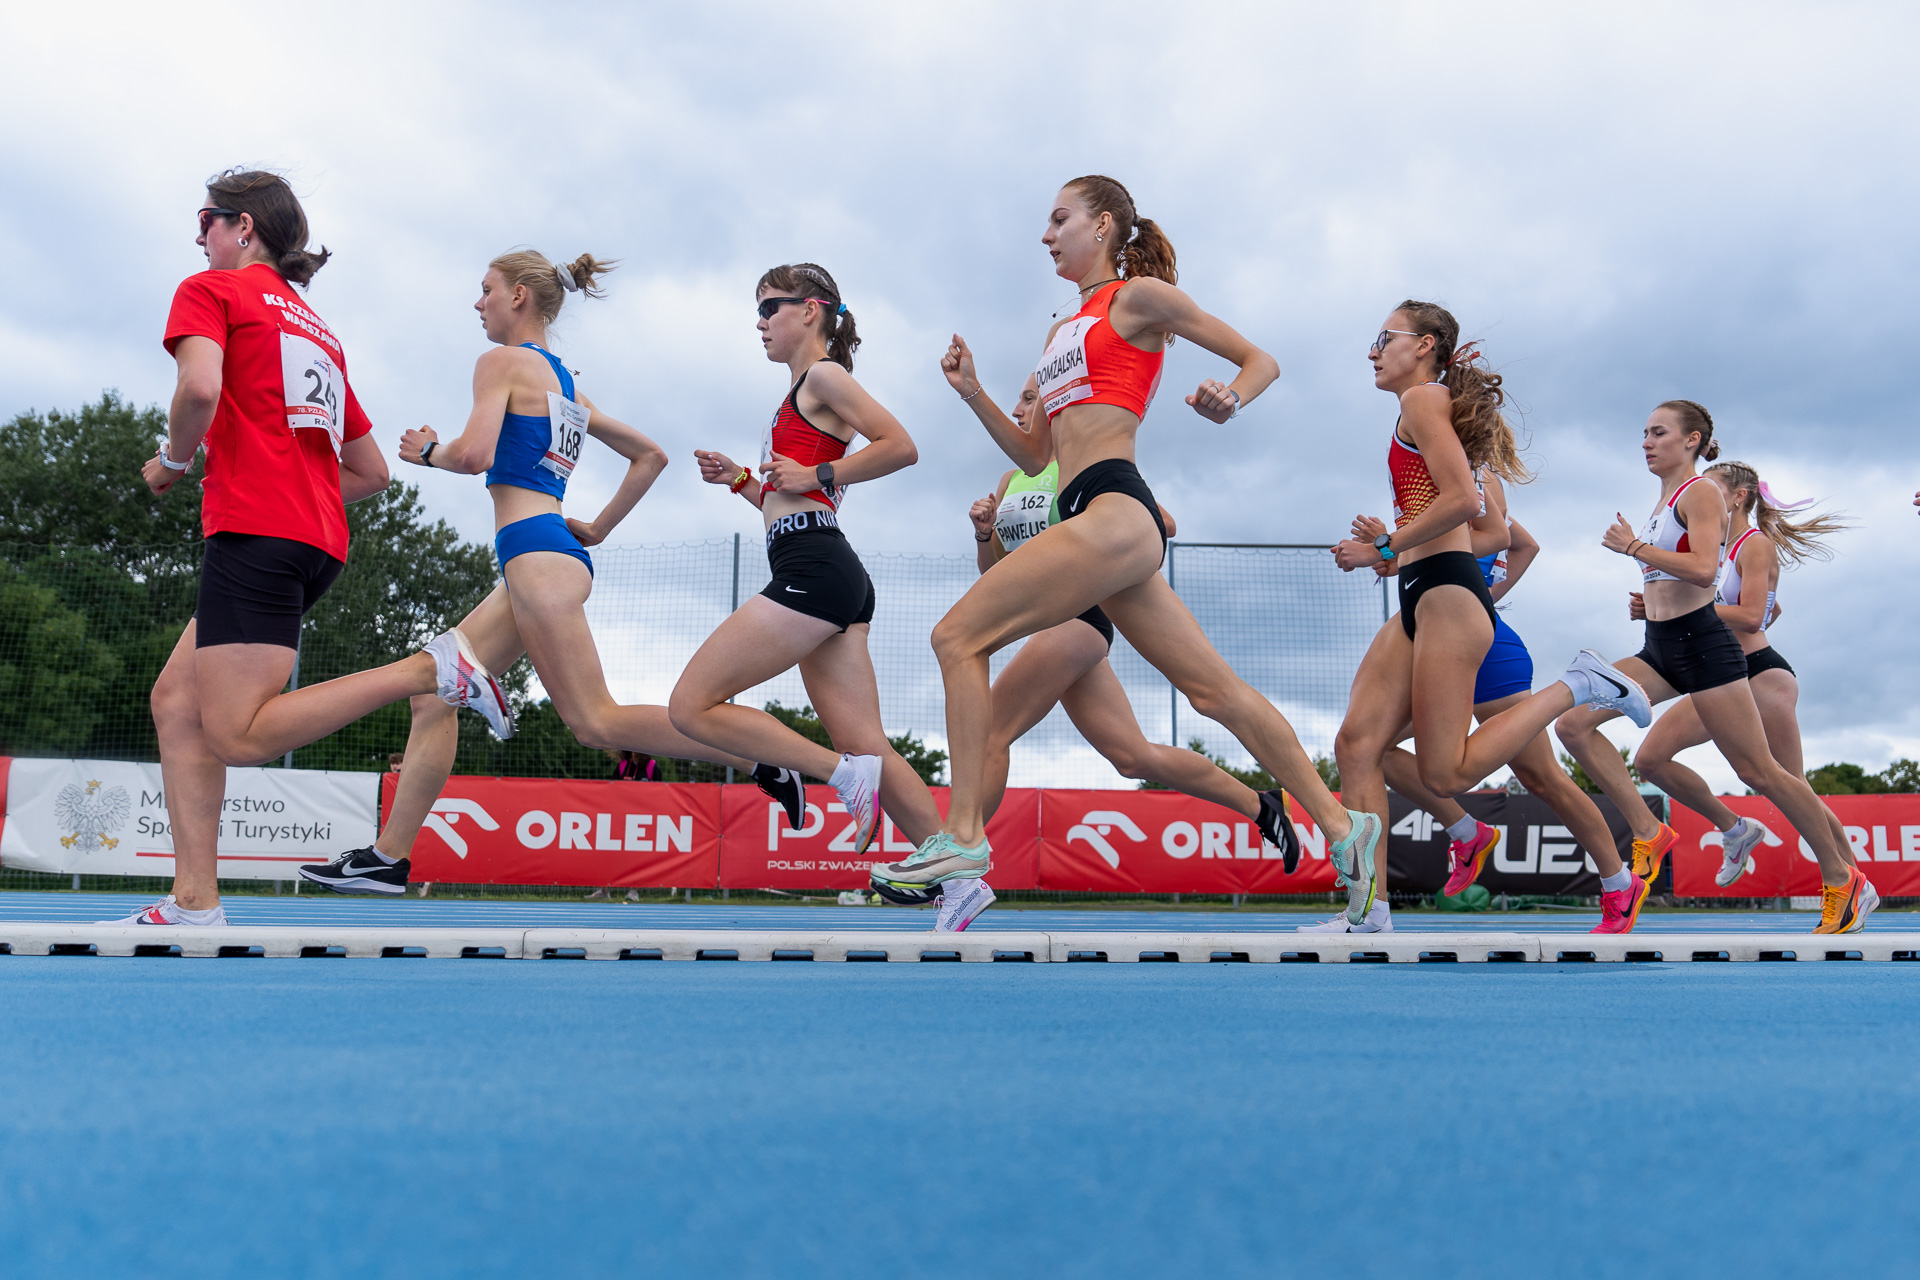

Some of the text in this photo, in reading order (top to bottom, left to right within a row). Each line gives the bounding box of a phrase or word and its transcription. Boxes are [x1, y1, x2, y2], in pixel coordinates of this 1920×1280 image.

[262, 293, 287, 308] KS
[281, 309, 341, 354] WARSZAWA
[1036, 345, 1084, 389] DOMŻALSKA
[558, 423, 582, 461] 168
[1021, 495, 1045, 511] 162
[771, 511, 808, 540] PRO
[815, 510, 839, 529] NIK
[997, 520, 1047, 543] PAWELUS
[140, 790, 285, 813] Mirstwo
[218, 820, 224, 838] i
[231, 820, 332, 843] Turystyki
[516, 810, 693, 853] ORLEN
[768, 802, 994, 852] PZL
[767, 860, 815, 870] POLSKI
[944, 887, 981, 930] new balance
